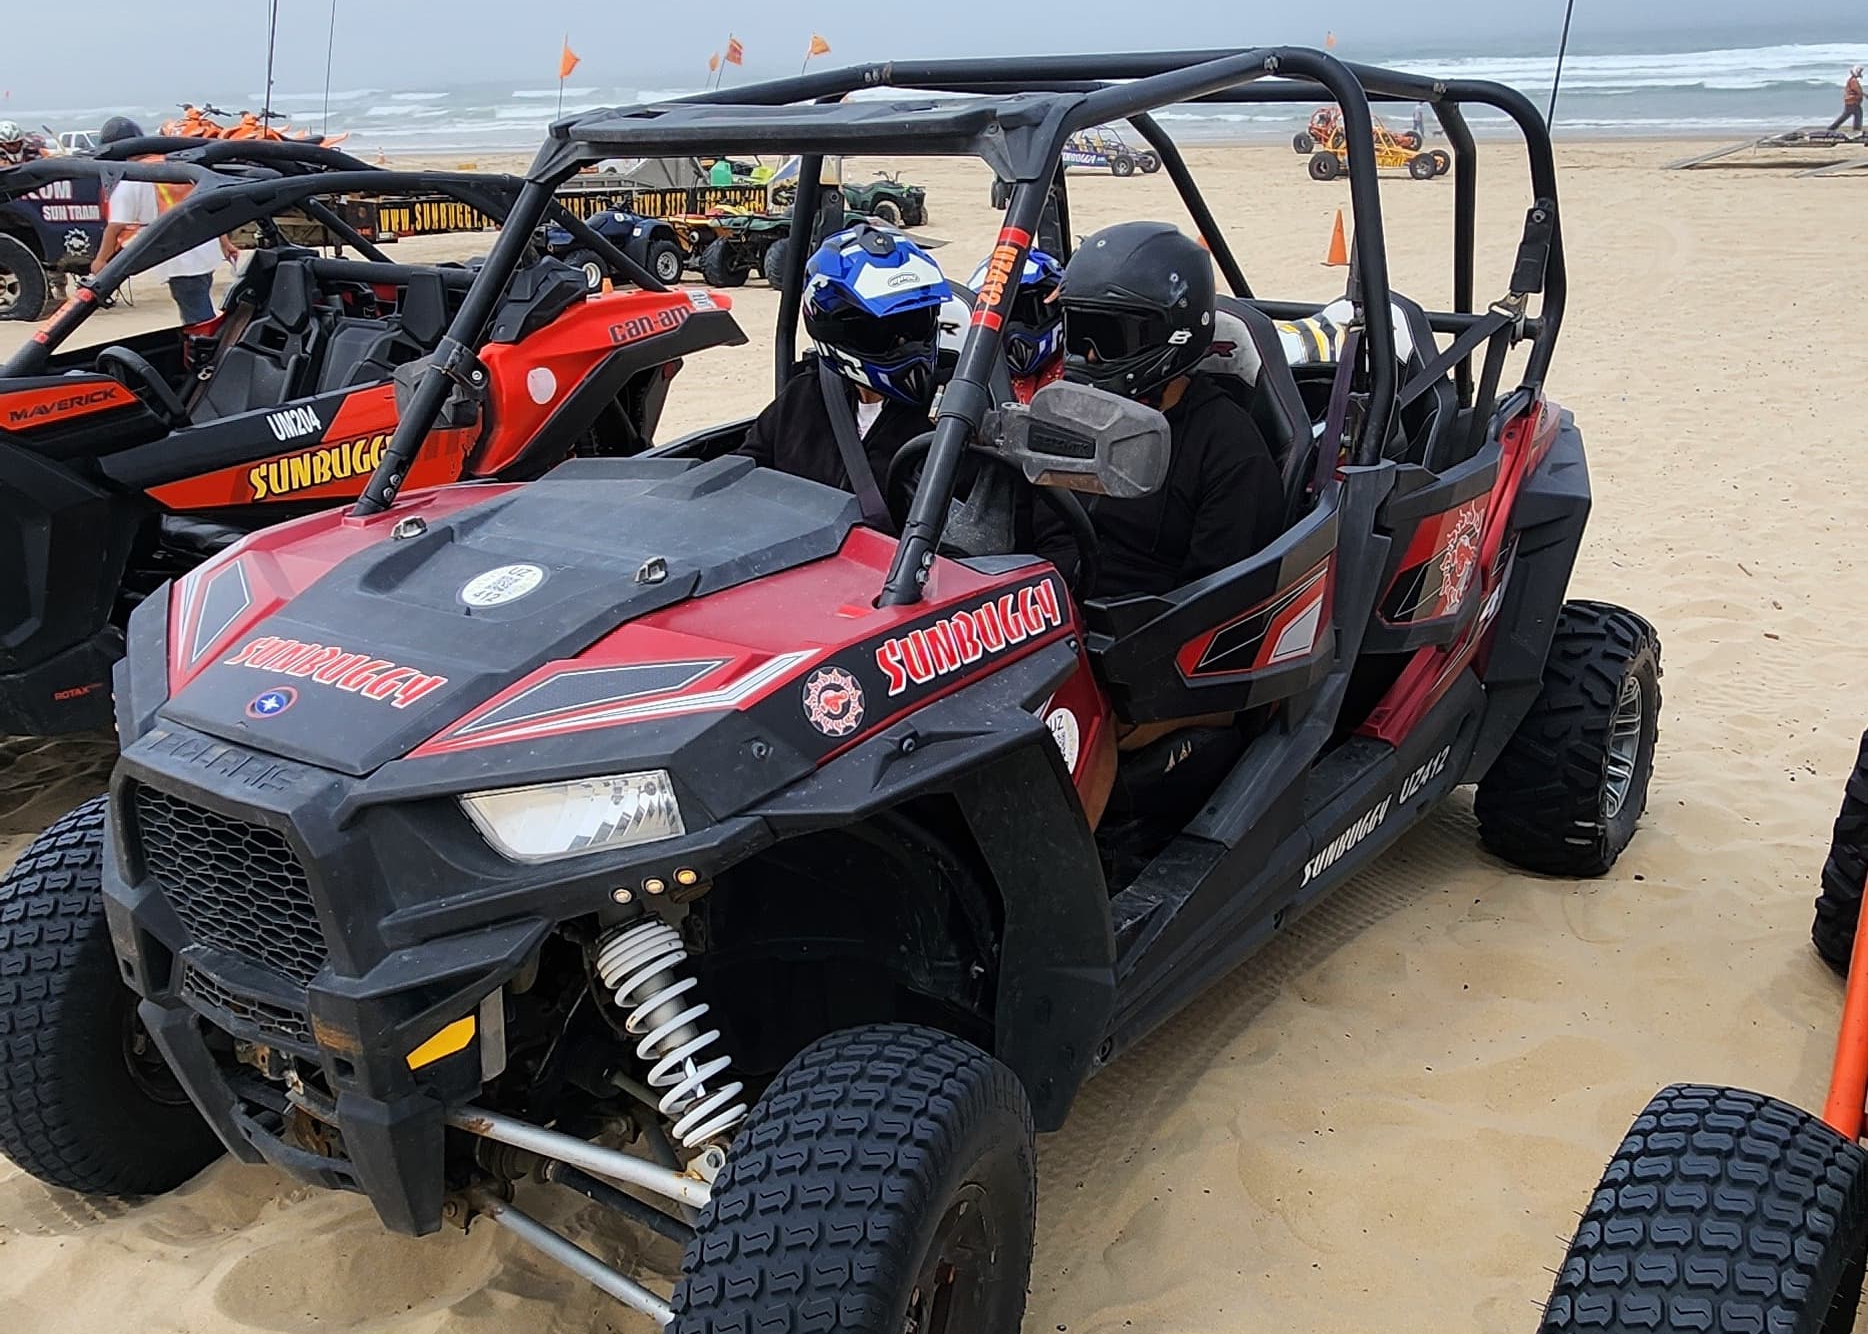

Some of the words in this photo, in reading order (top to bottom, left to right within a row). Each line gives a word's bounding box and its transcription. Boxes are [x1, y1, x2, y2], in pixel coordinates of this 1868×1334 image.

[609, 305, 691, 344] can-am
[9, 387, 117, 422] MAVERICK
[266, 405, 322, 441] UM204
[250, 435, 393, 500] SUNBUGG
[875, 578, 1062, 697] SUNBUGGY
[54, 687, 89, 700] ROTAX
[224, 636, 449, 709] SUNBUGGY
[148, 731, 298, 793] POLARIS
[1300, 793, 1393, 889] SUNBUGGY
[1399, 745, 1451, 805] UZ412
